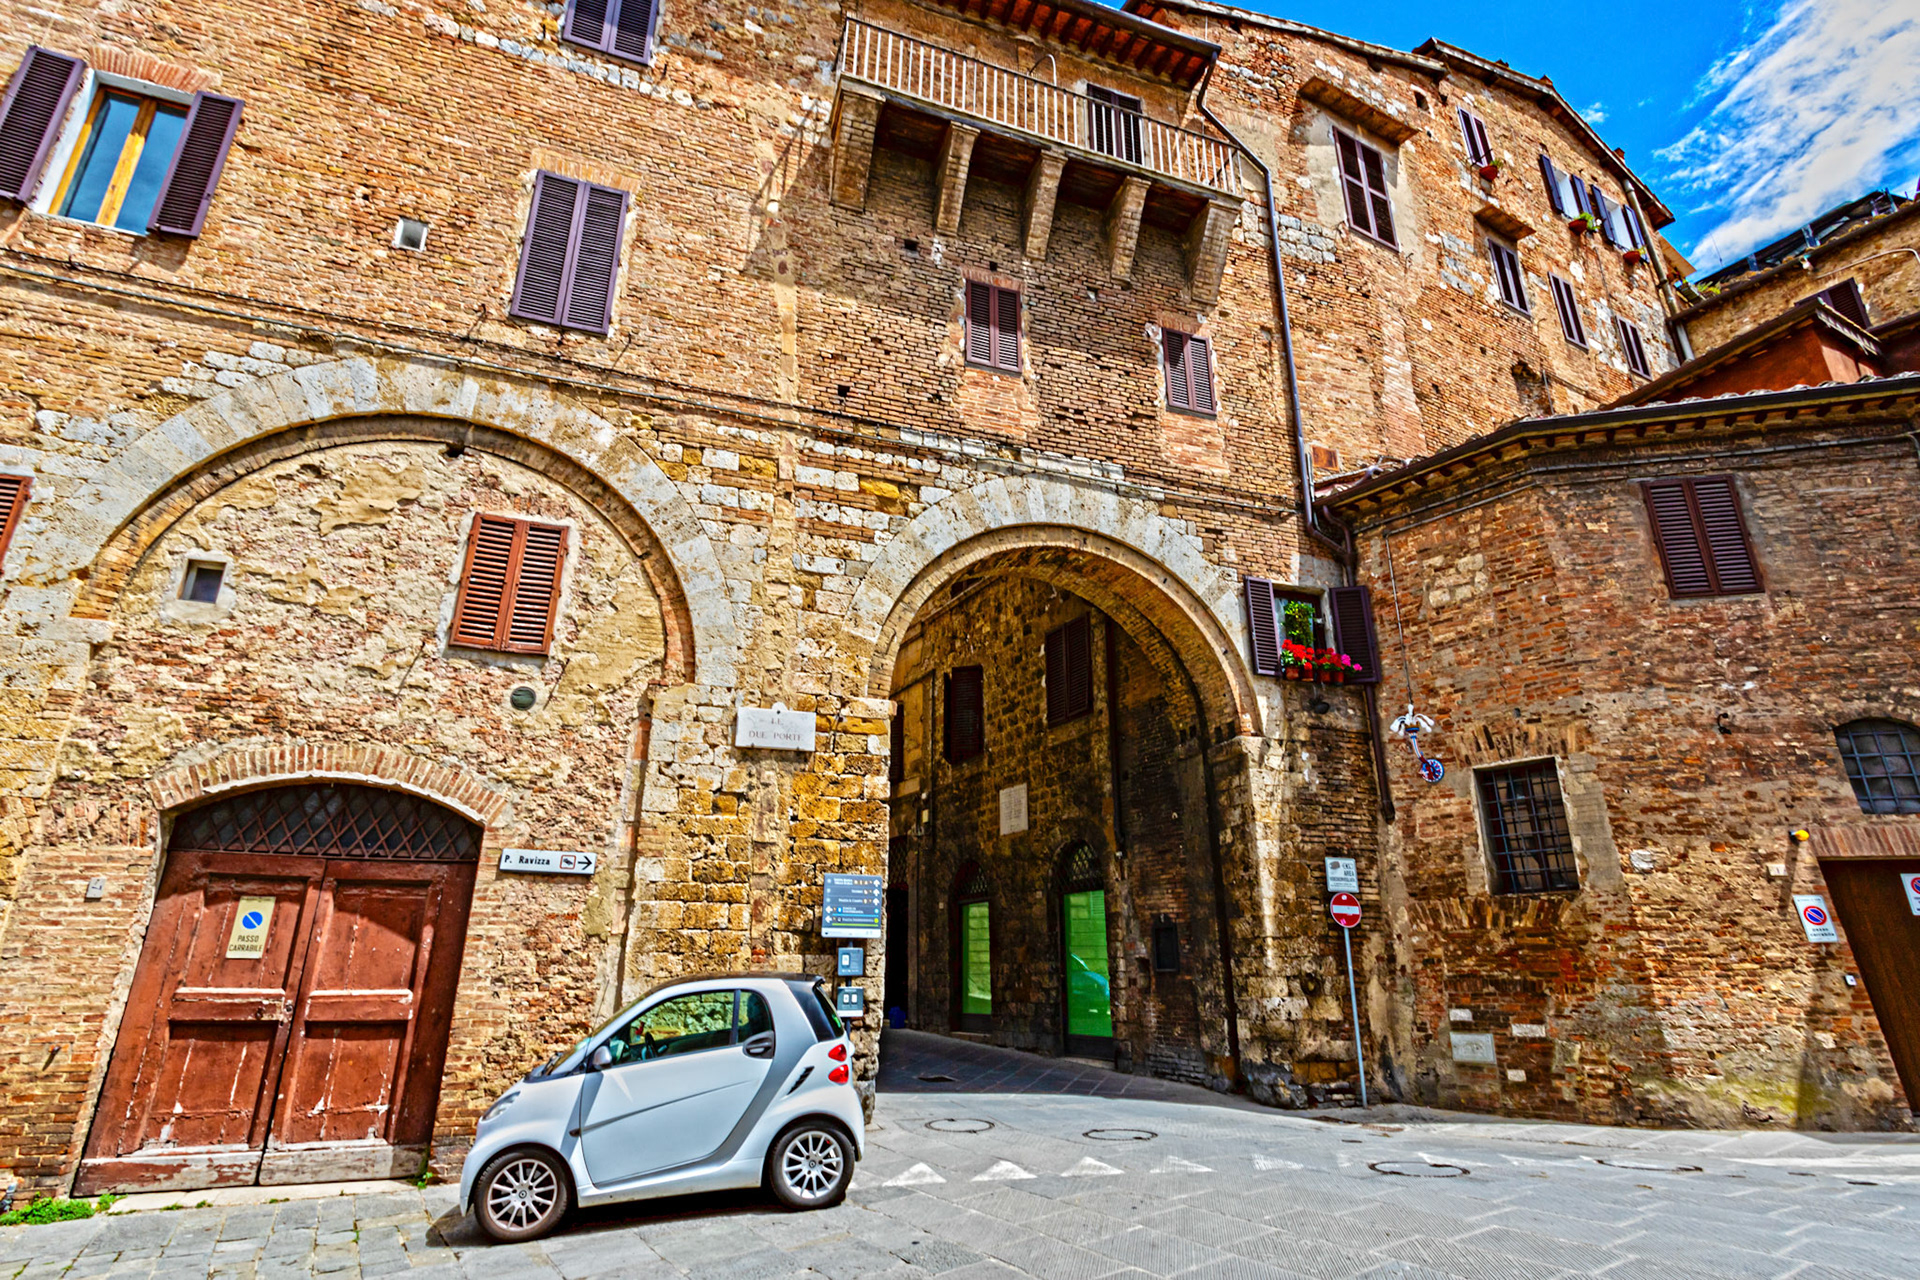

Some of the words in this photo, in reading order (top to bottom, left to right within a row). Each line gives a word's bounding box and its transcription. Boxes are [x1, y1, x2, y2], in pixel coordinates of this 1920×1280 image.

[748, 730, 767, 739] DUE
[773, 732, 804, 742] PORTE
[504, 854, 512, 864] P.
[518, 855, 550, 866] Ravizza
[237, 935, 260, 943] PASSO
[228, 944, 263, 952] CARRABILE
